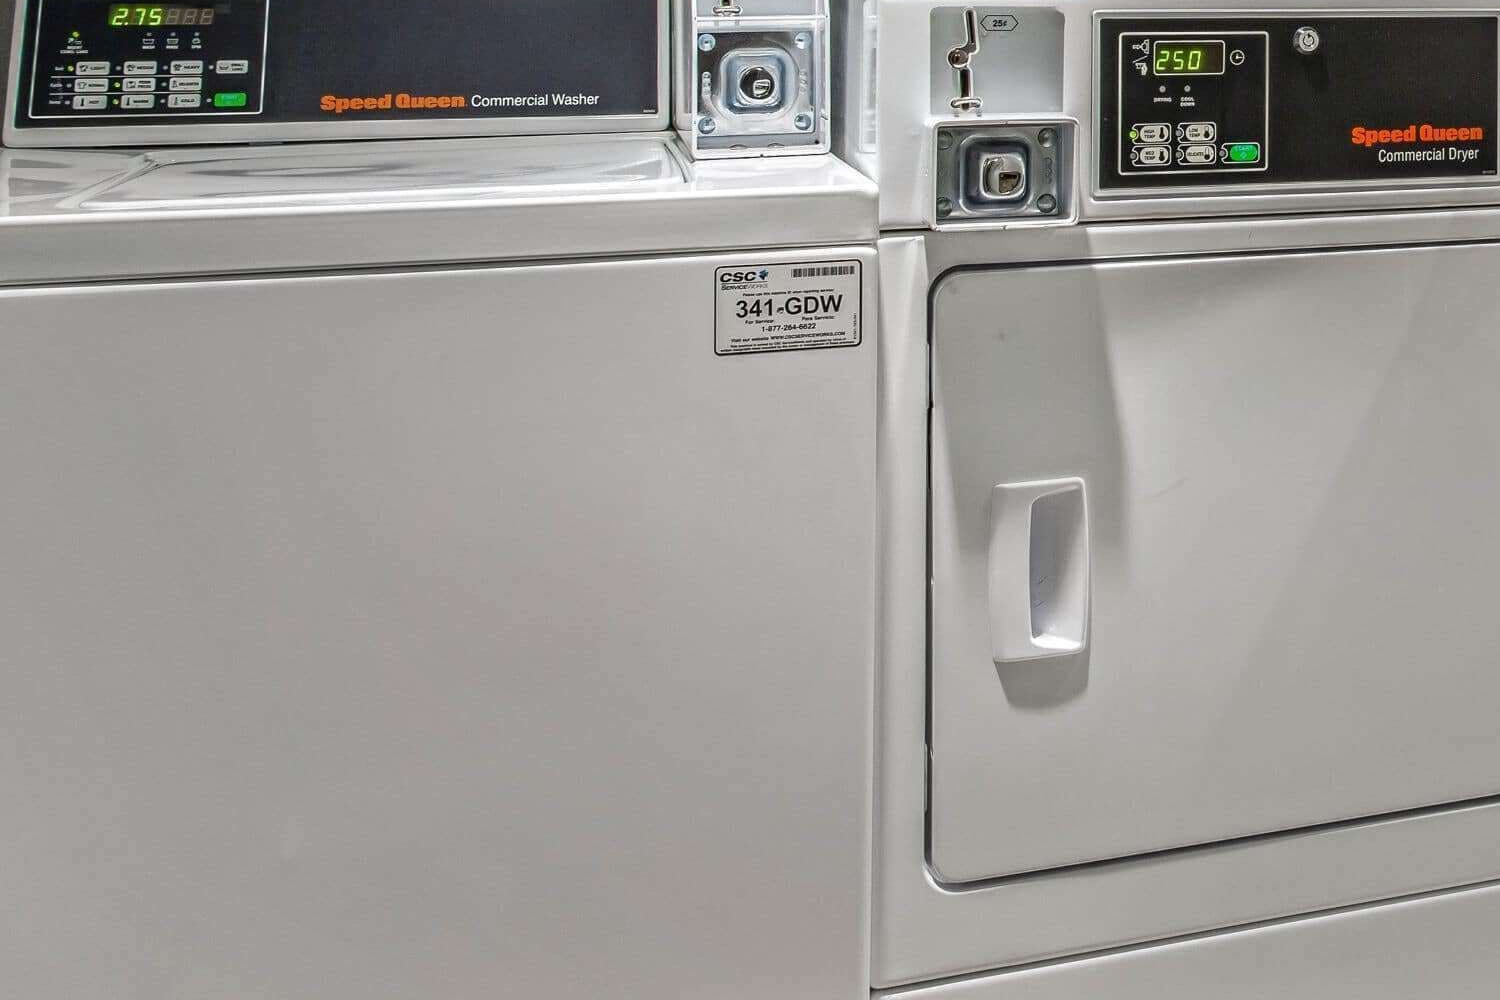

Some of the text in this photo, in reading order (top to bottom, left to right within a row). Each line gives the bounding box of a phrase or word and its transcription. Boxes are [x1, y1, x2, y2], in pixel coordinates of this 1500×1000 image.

[112, 8, 162, 26] 2.75
[992, 19, 1007, 27] 25¢
[320, 93, 600, 112] Speed Queen Commercial Washer
[1352, 124, 1483, 146] Speed Queen
[1378, 147, 1479, 162] Commercial Dryer
[720, 272, 757, 282] CSC
[736, 294, 843, 318] 341-GDW
[762, 323, 816, 332] 1-877-264-6622
